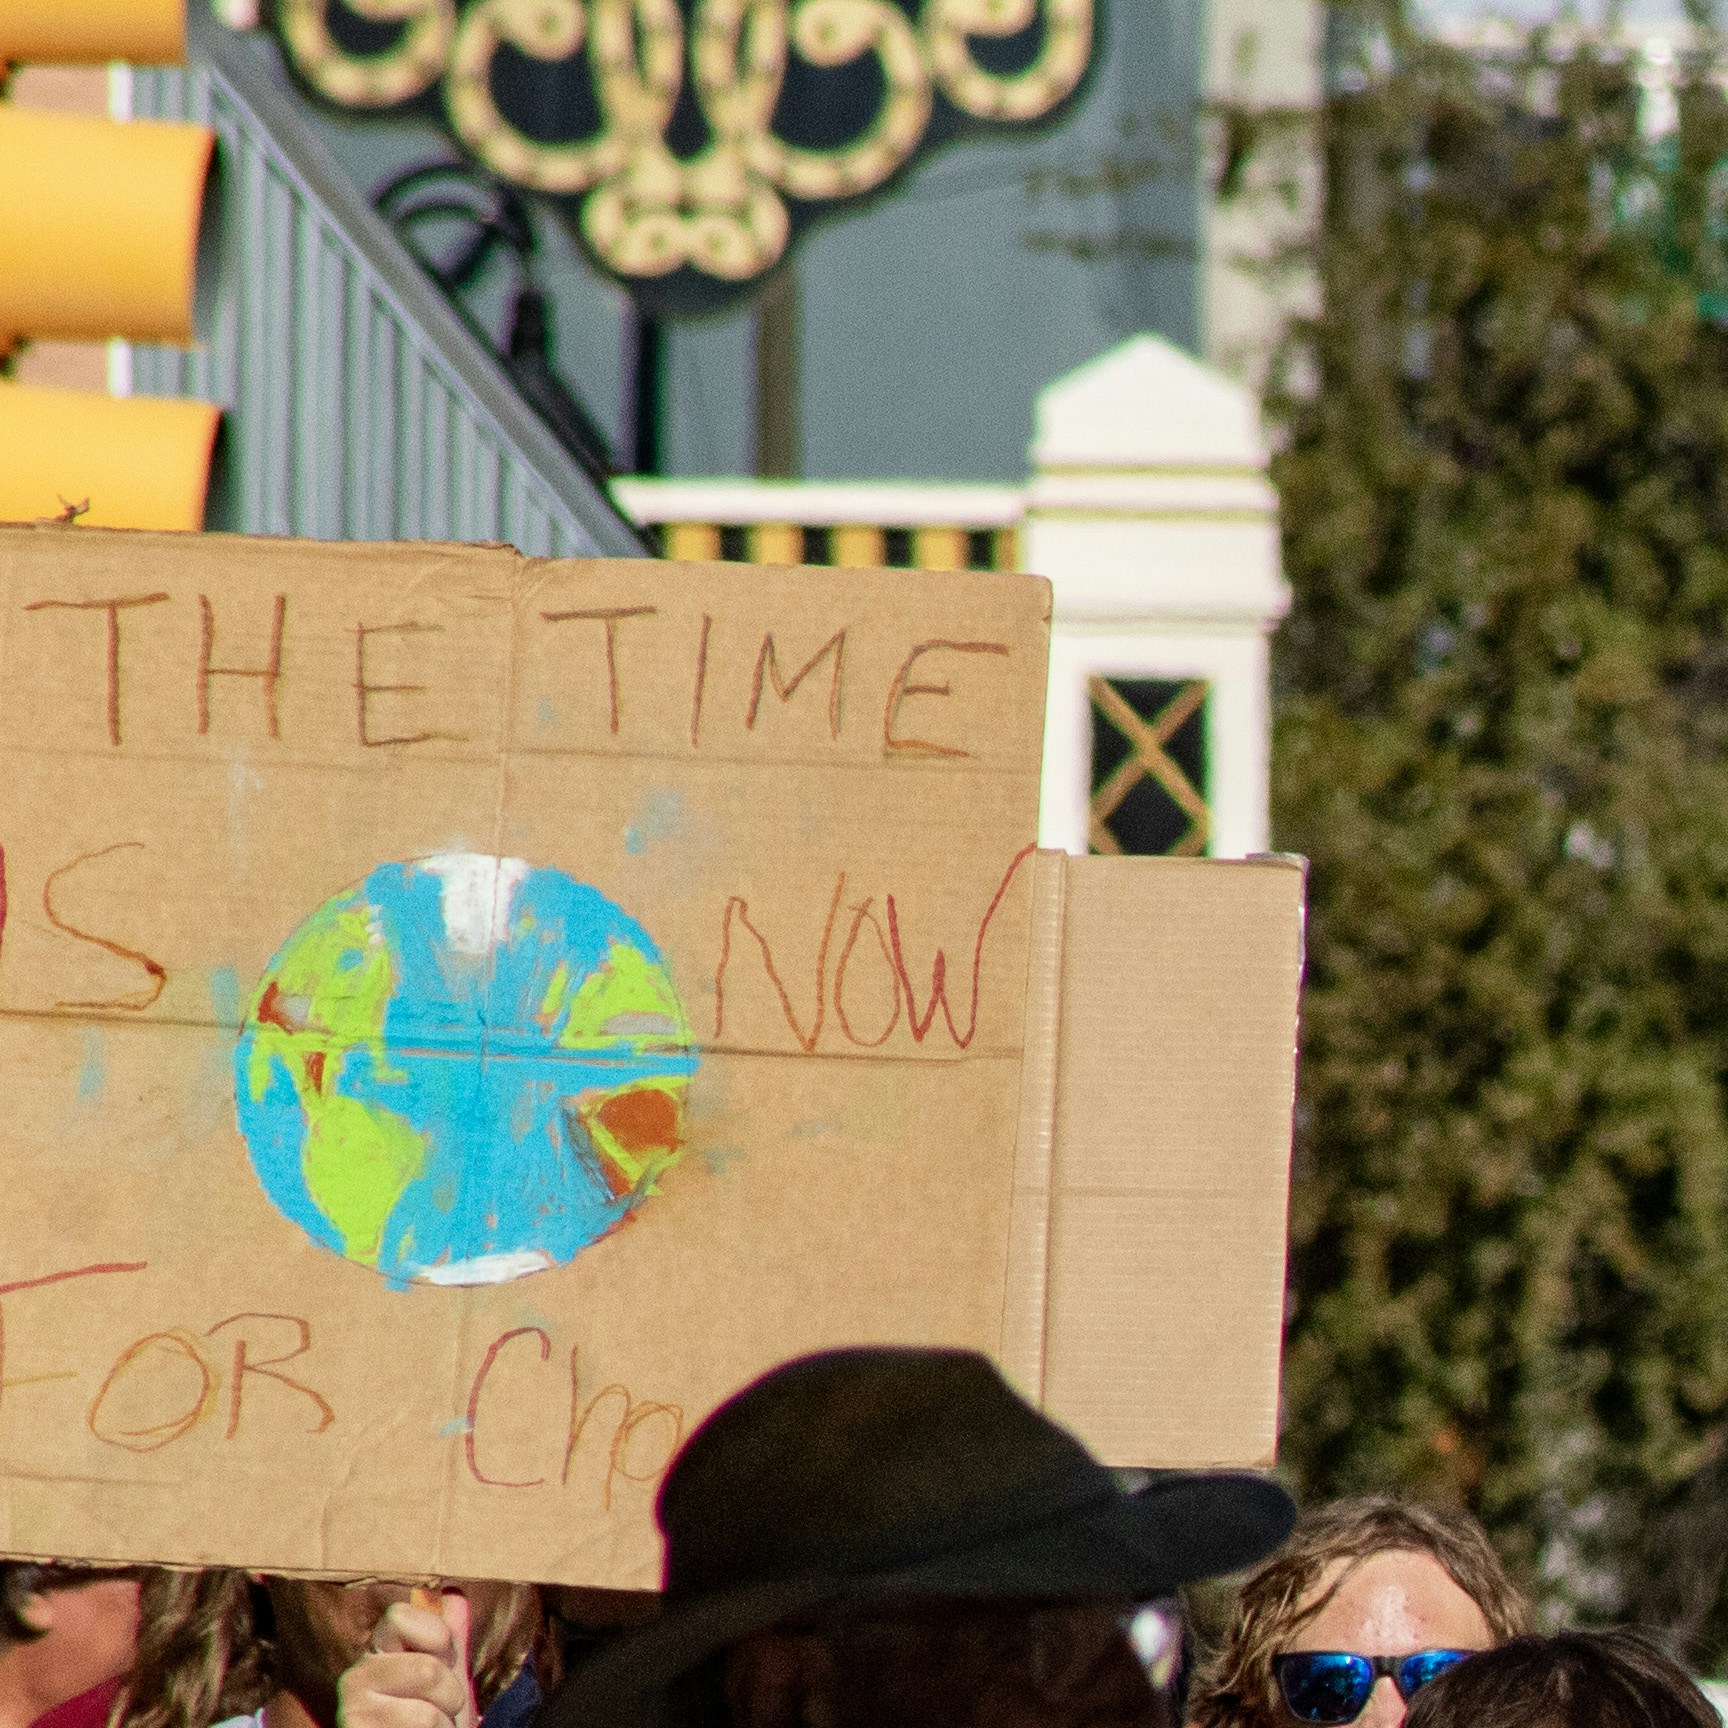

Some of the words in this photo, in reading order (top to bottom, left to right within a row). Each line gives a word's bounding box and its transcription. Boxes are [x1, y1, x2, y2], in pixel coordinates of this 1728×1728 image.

[24, 592, 469, 747] THE
[539, 605, 1009, 759] TIME
[713, 842, 1038, 1050] NOW
[0, 1261, 336, 1454] FOR
